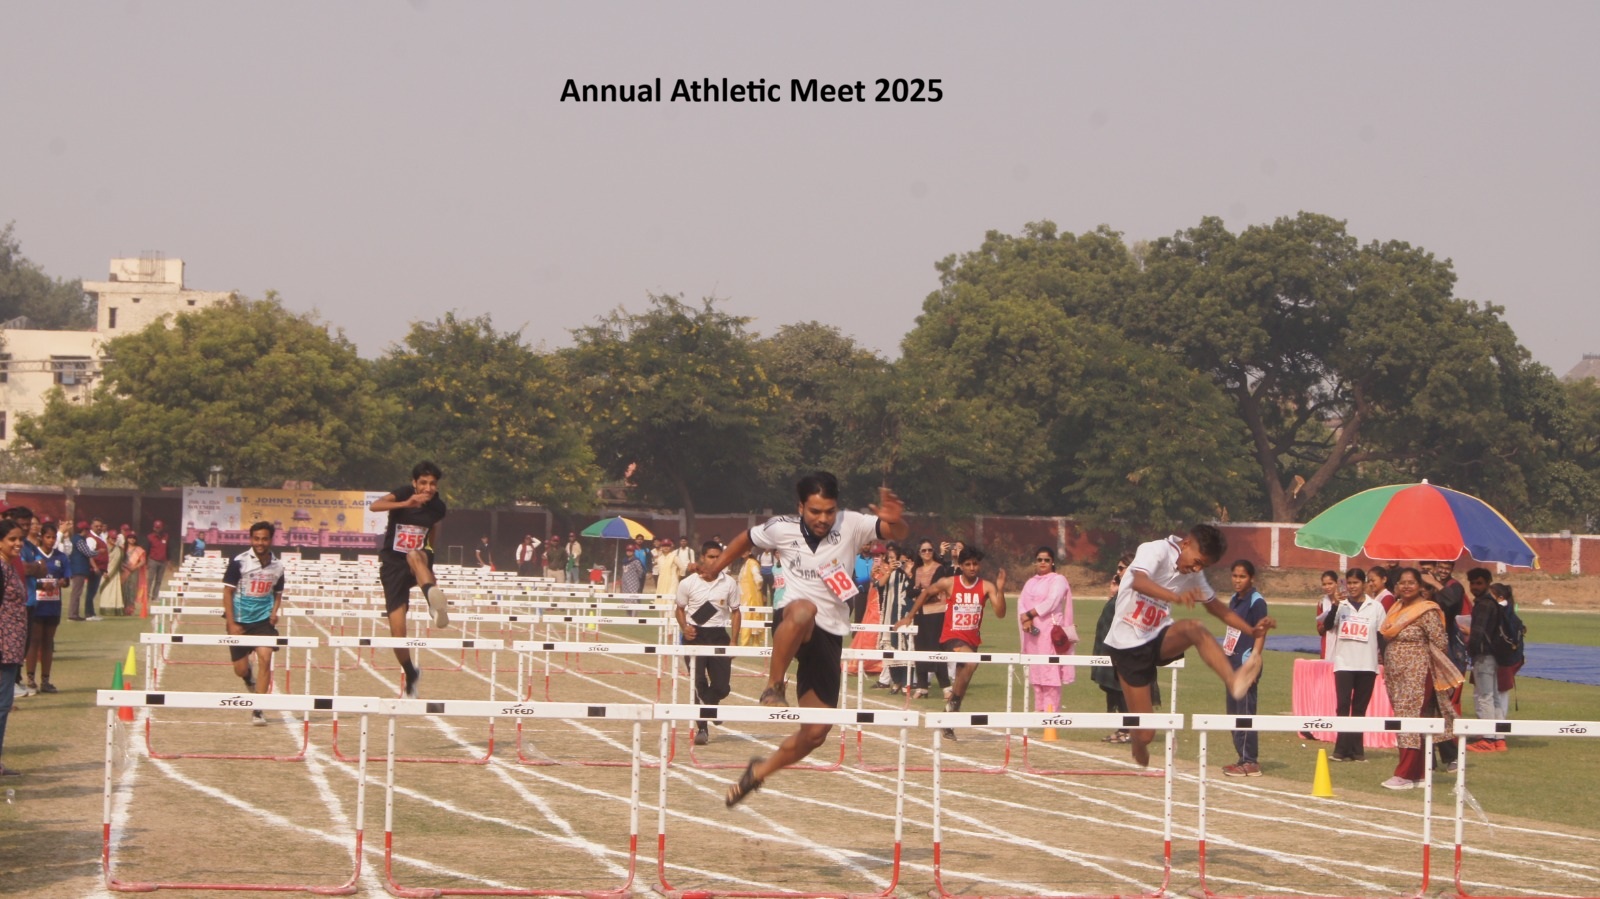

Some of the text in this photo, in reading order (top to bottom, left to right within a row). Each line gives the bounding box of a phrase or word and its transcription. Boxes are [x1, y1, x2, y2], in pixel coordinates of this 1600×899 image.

[955, 592, 980, 604] SHA
[1341, 621, 1368, 638] 404
[501, 707, 534, 715] STEED
